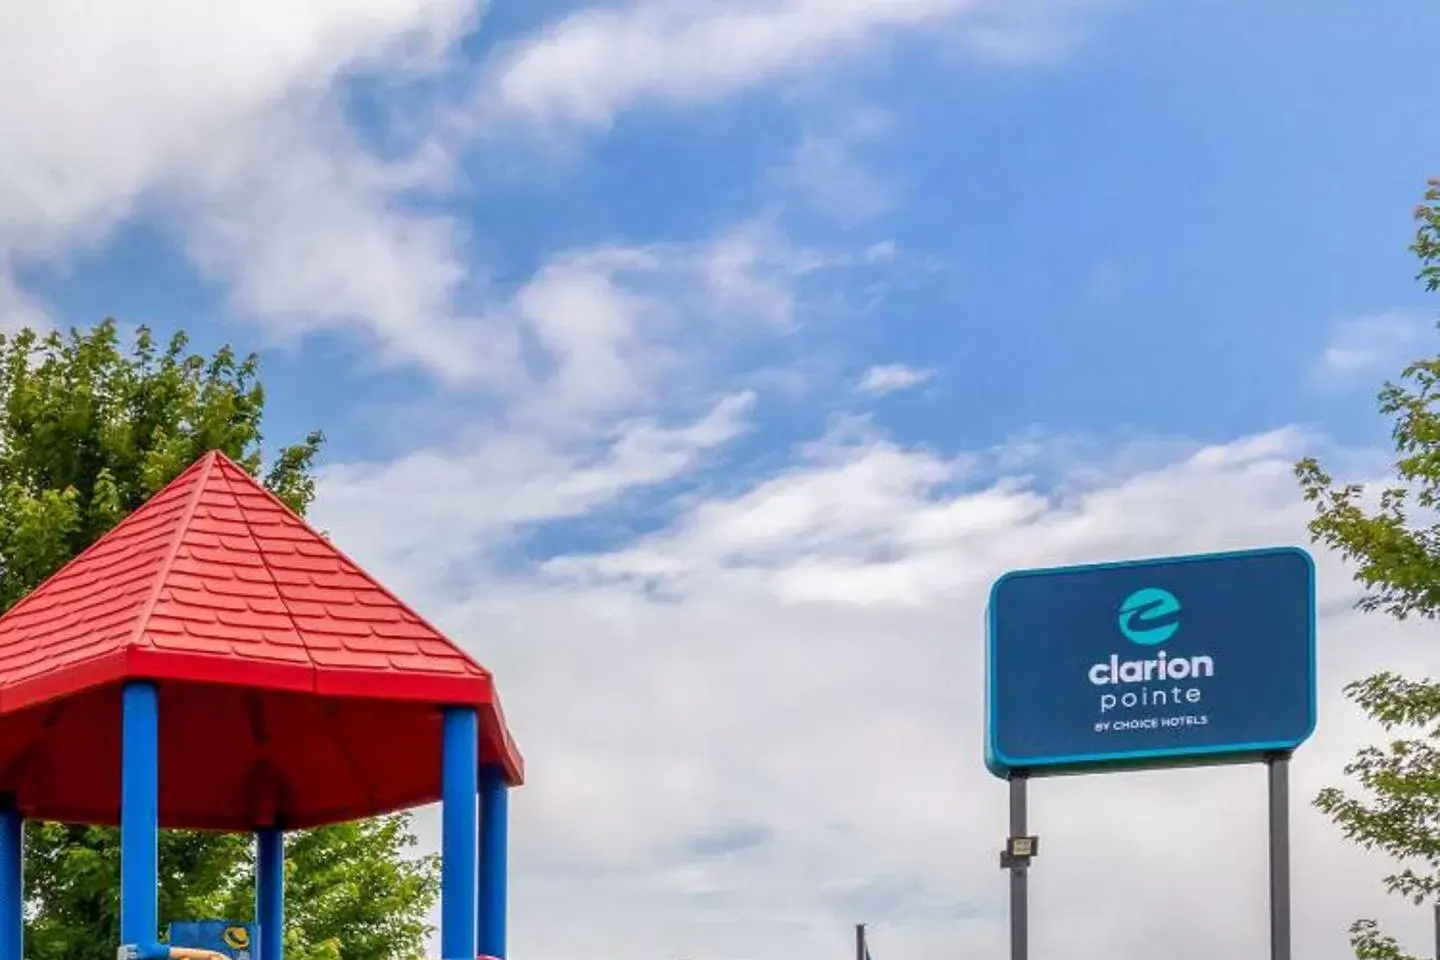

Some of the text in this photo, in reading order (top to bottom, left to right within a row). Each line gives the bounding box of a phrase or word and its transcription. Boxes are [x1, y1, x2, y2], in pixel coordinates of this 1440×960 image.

[1088, 650, 1214, 685] clarion
[1101, 687, 1201, 713] pointe
[1094, 715, 1209, 732] BY CHOICE HOTELS
